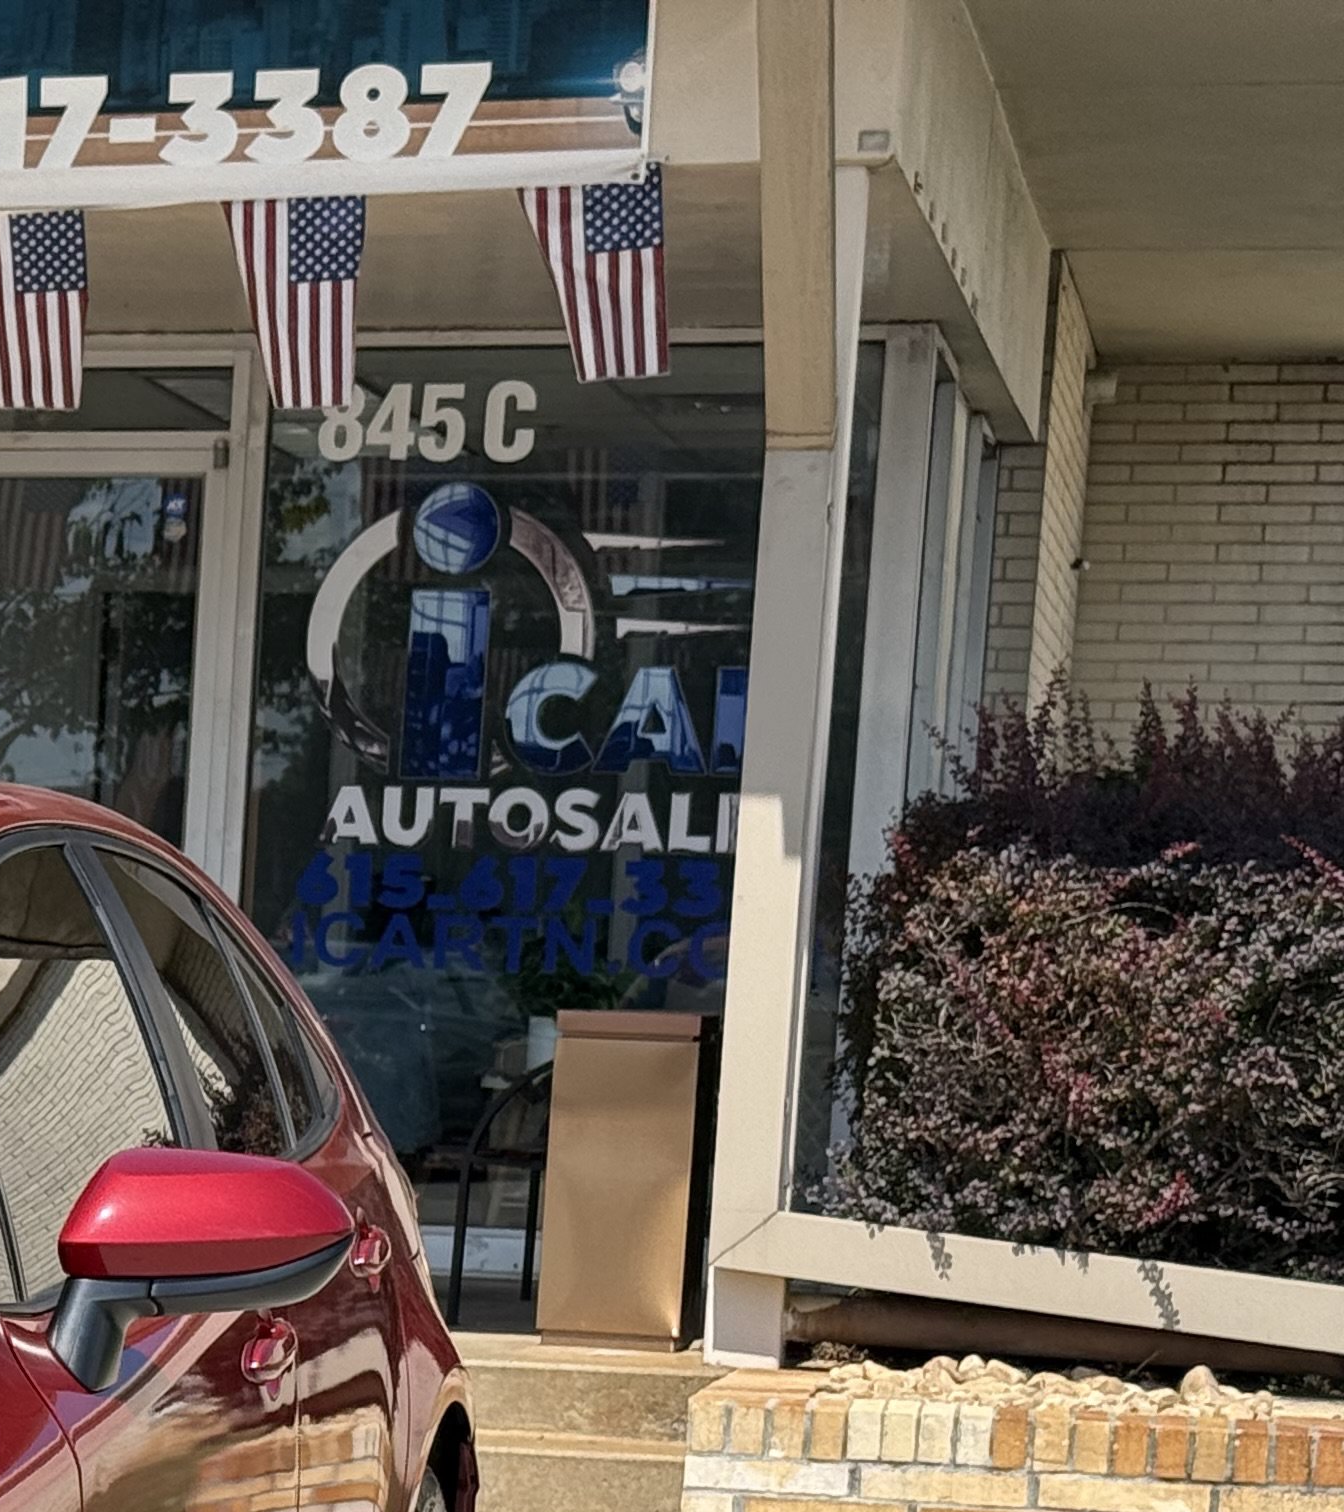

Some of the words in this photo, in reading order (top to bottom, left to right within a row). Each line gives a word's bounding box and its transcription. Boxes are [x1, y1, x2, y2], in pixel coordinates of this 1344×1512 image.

[318, 383, 466, 463] 845
[484, 380, 537, 463] C
[399, 483, 747, 779] iCA
